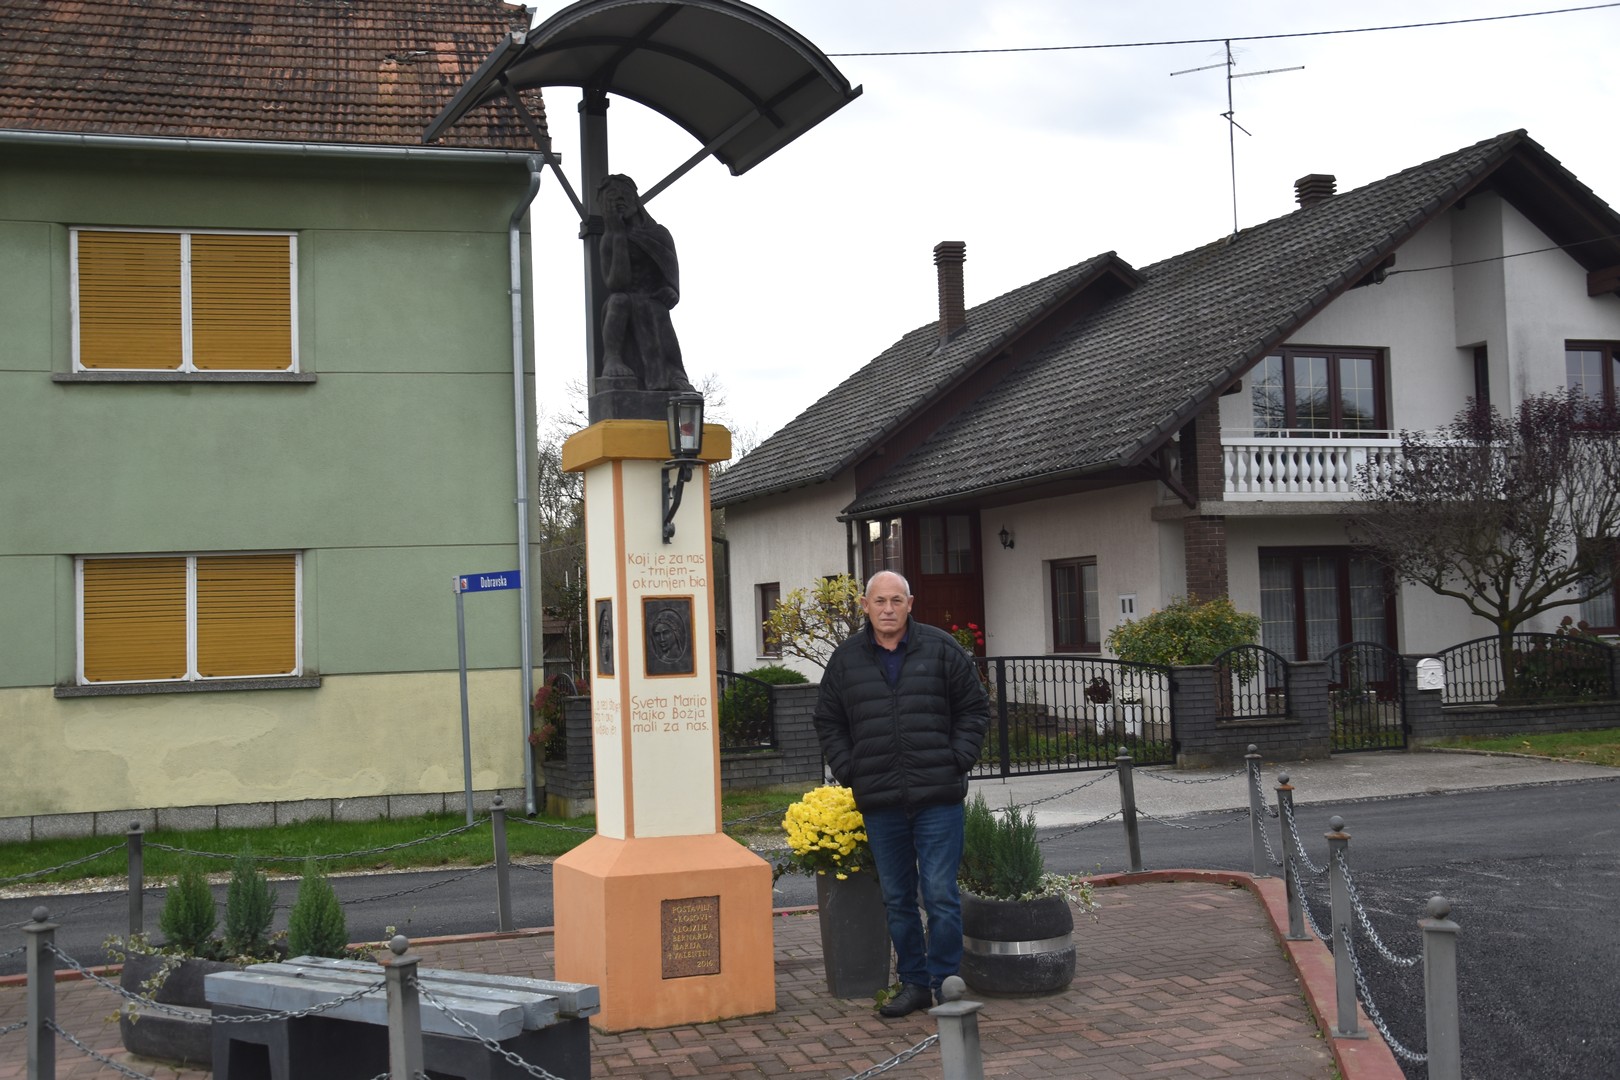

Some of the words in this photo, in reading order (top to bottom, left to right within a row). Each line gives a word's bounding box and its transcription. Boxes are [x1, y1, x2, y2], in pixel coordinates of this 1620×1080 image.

[628, 553, 649, 566] Koji
[655, 553, 665, 566] je
[669, 554, 683, 564] za
[686, 554, 704, 563] nas
[480, 575, 507, 588] Dubravska
[633, 578, 686, 591] okrunjen
[632, 696, 668, 710] Sveta
[674, 694, 707, 707] Marijo
[632, 710, 665, 722] Majko
[672, 707, 705, 720] Božja
[664, 723, 679, 732] za
[687, 722, 709, 731] nas.
[673, 933, 713, 942] BERNARDA
[672, 942, 701, 950] MARIJA
